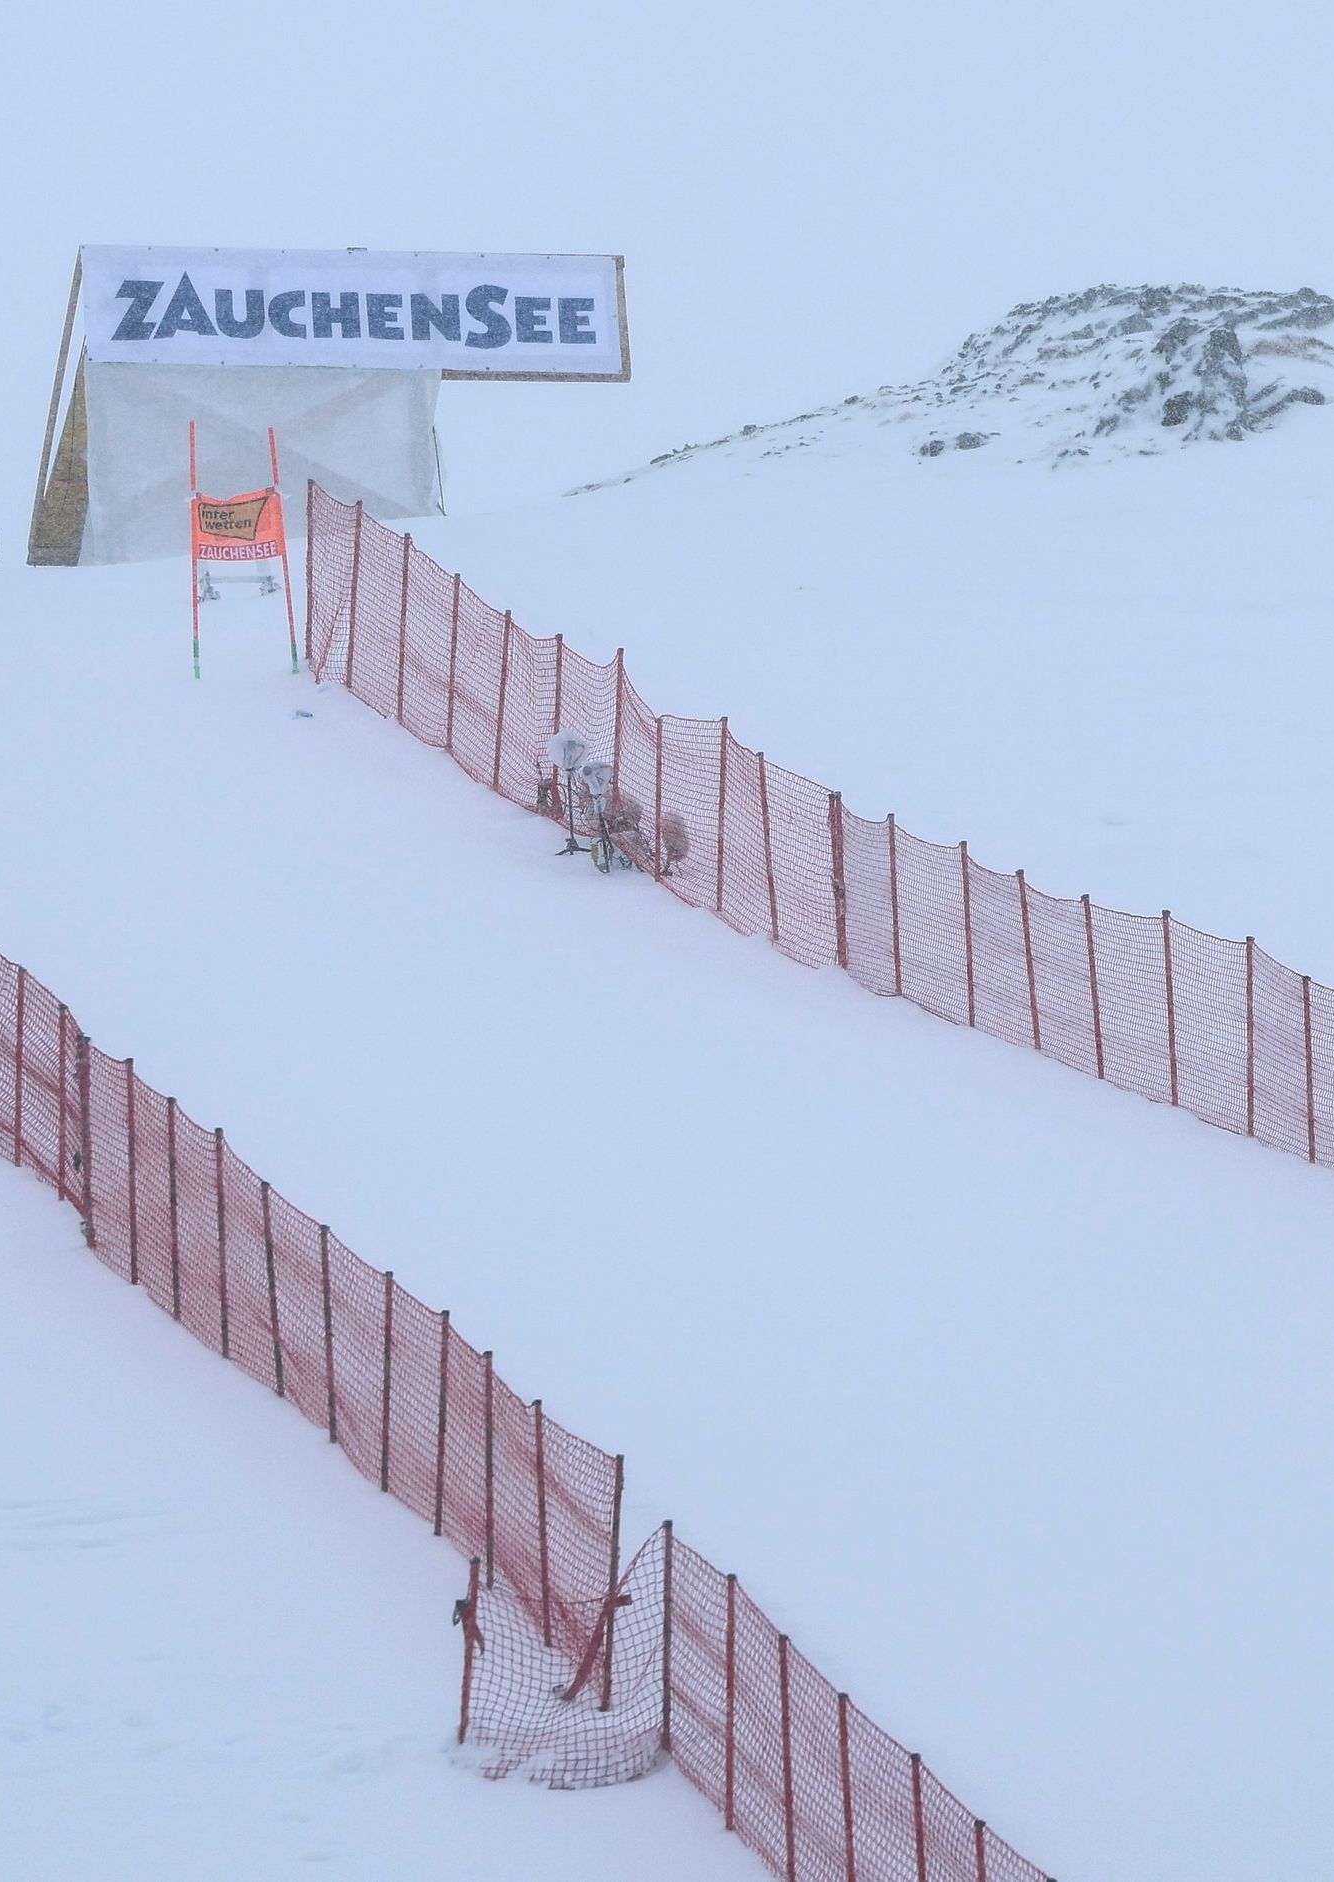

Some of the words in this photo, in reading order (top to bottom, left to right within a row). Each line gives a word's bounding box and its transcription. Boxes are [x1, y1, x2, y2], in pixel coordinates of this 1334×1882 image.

[110, 271, 597, 349] ZAUCHENSEE
[201, 503, 235, 520] inter
[205, 519, 252, 530] wetten
[200, 541, 277, 559] ZAUCHENSEE
